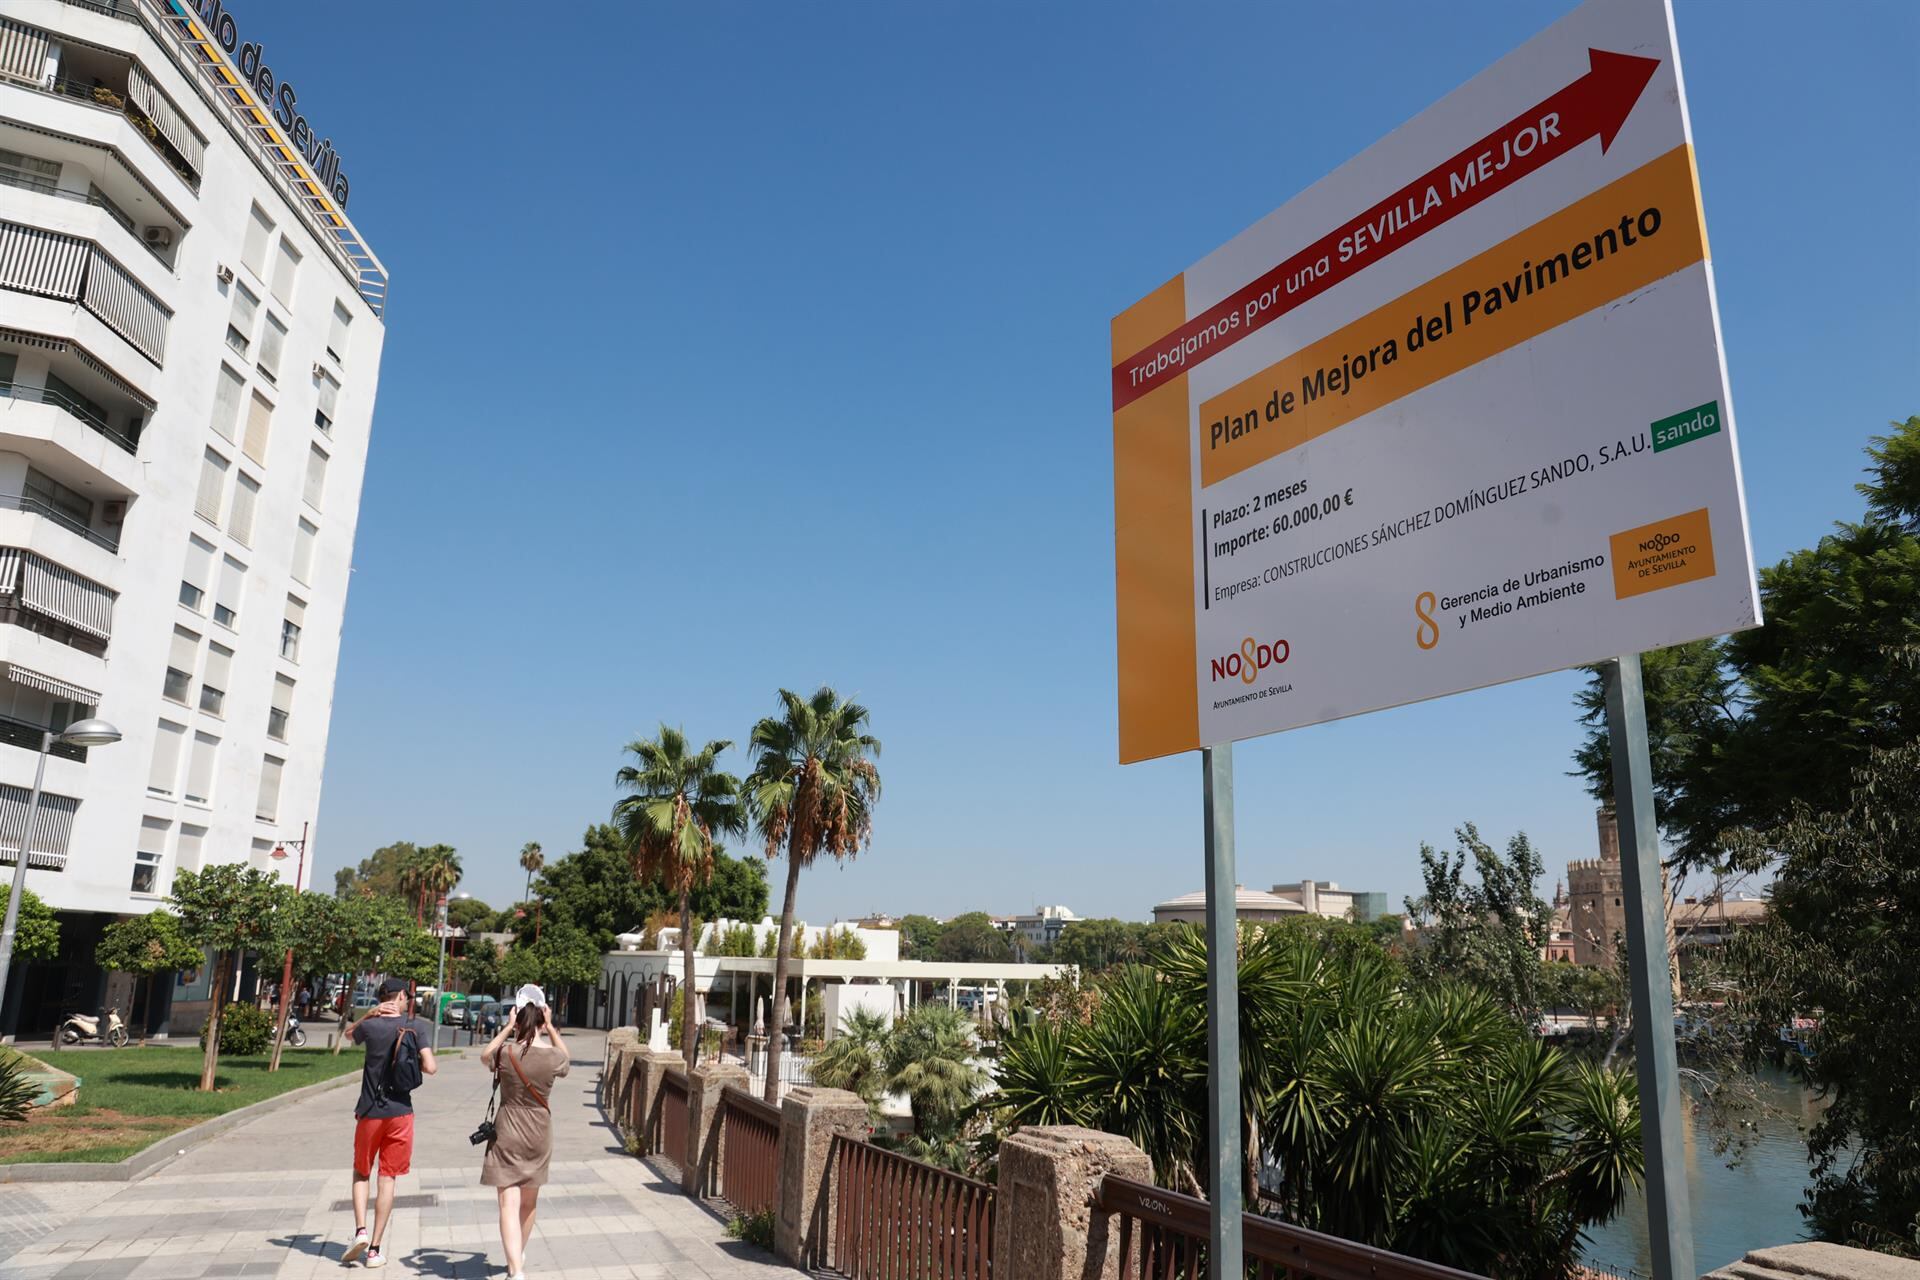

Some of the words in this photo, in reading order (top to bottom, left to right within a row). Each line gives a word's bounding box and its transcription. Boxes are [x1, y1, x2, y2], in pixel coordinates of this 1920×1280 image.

[239, 41, 275, 107] de
[274, 80, 350, 211] Sevilla
[1129, 311, 1240, 387] Trabajamos
[1245, 283, 1280, 327] por
[1286, 255, 1330, 294] una
[1338, 185, 1443, 263] SEVILLA
[1449, 112, 1561, 198] MEJOR
[1210, 408, 1259, 450] Plan
[1265, 390, 1295, 422] de
[1302, 338, 1398, 405] Mejora
[1406, 302, 1453, 352] del
[1462, 207, 1662, 326] Pavimento
[1656, 412, 1715, 444] sando
[1213, 503, 1250, 529] Plazo:
[1253, 496, 1261, 513] 2
[1264, 479, 1308, 509] meses
[1214, 525, 1270, 557] Importe:
[1272, 494, 1340, 535] 60.000,00
[1344, 488, 1354, 506] €
[1215, 575, 1261, 601] Empresa:
[1263, 534, 1369, 584] CONSTRUCCIONES
[1371, 510, 1431, 547] SÁNCHEZ
[1434, 475, 1527, 523] DOMÍNGUEZ
[1530, 453, 1595, 489] SANDO,
[1599, 433, 1651, 465] S.A.U.
[1440, 584, 1499, 611] Gerencia
[1502, 579, 1520, 594] de
[1524, 554, 1605, 587] Urbanismo
[1458, 614, 1467, 629] y
[1470, 601, 1512, 623] Medio
[1516, 581, 1586, 611] Ambiente
